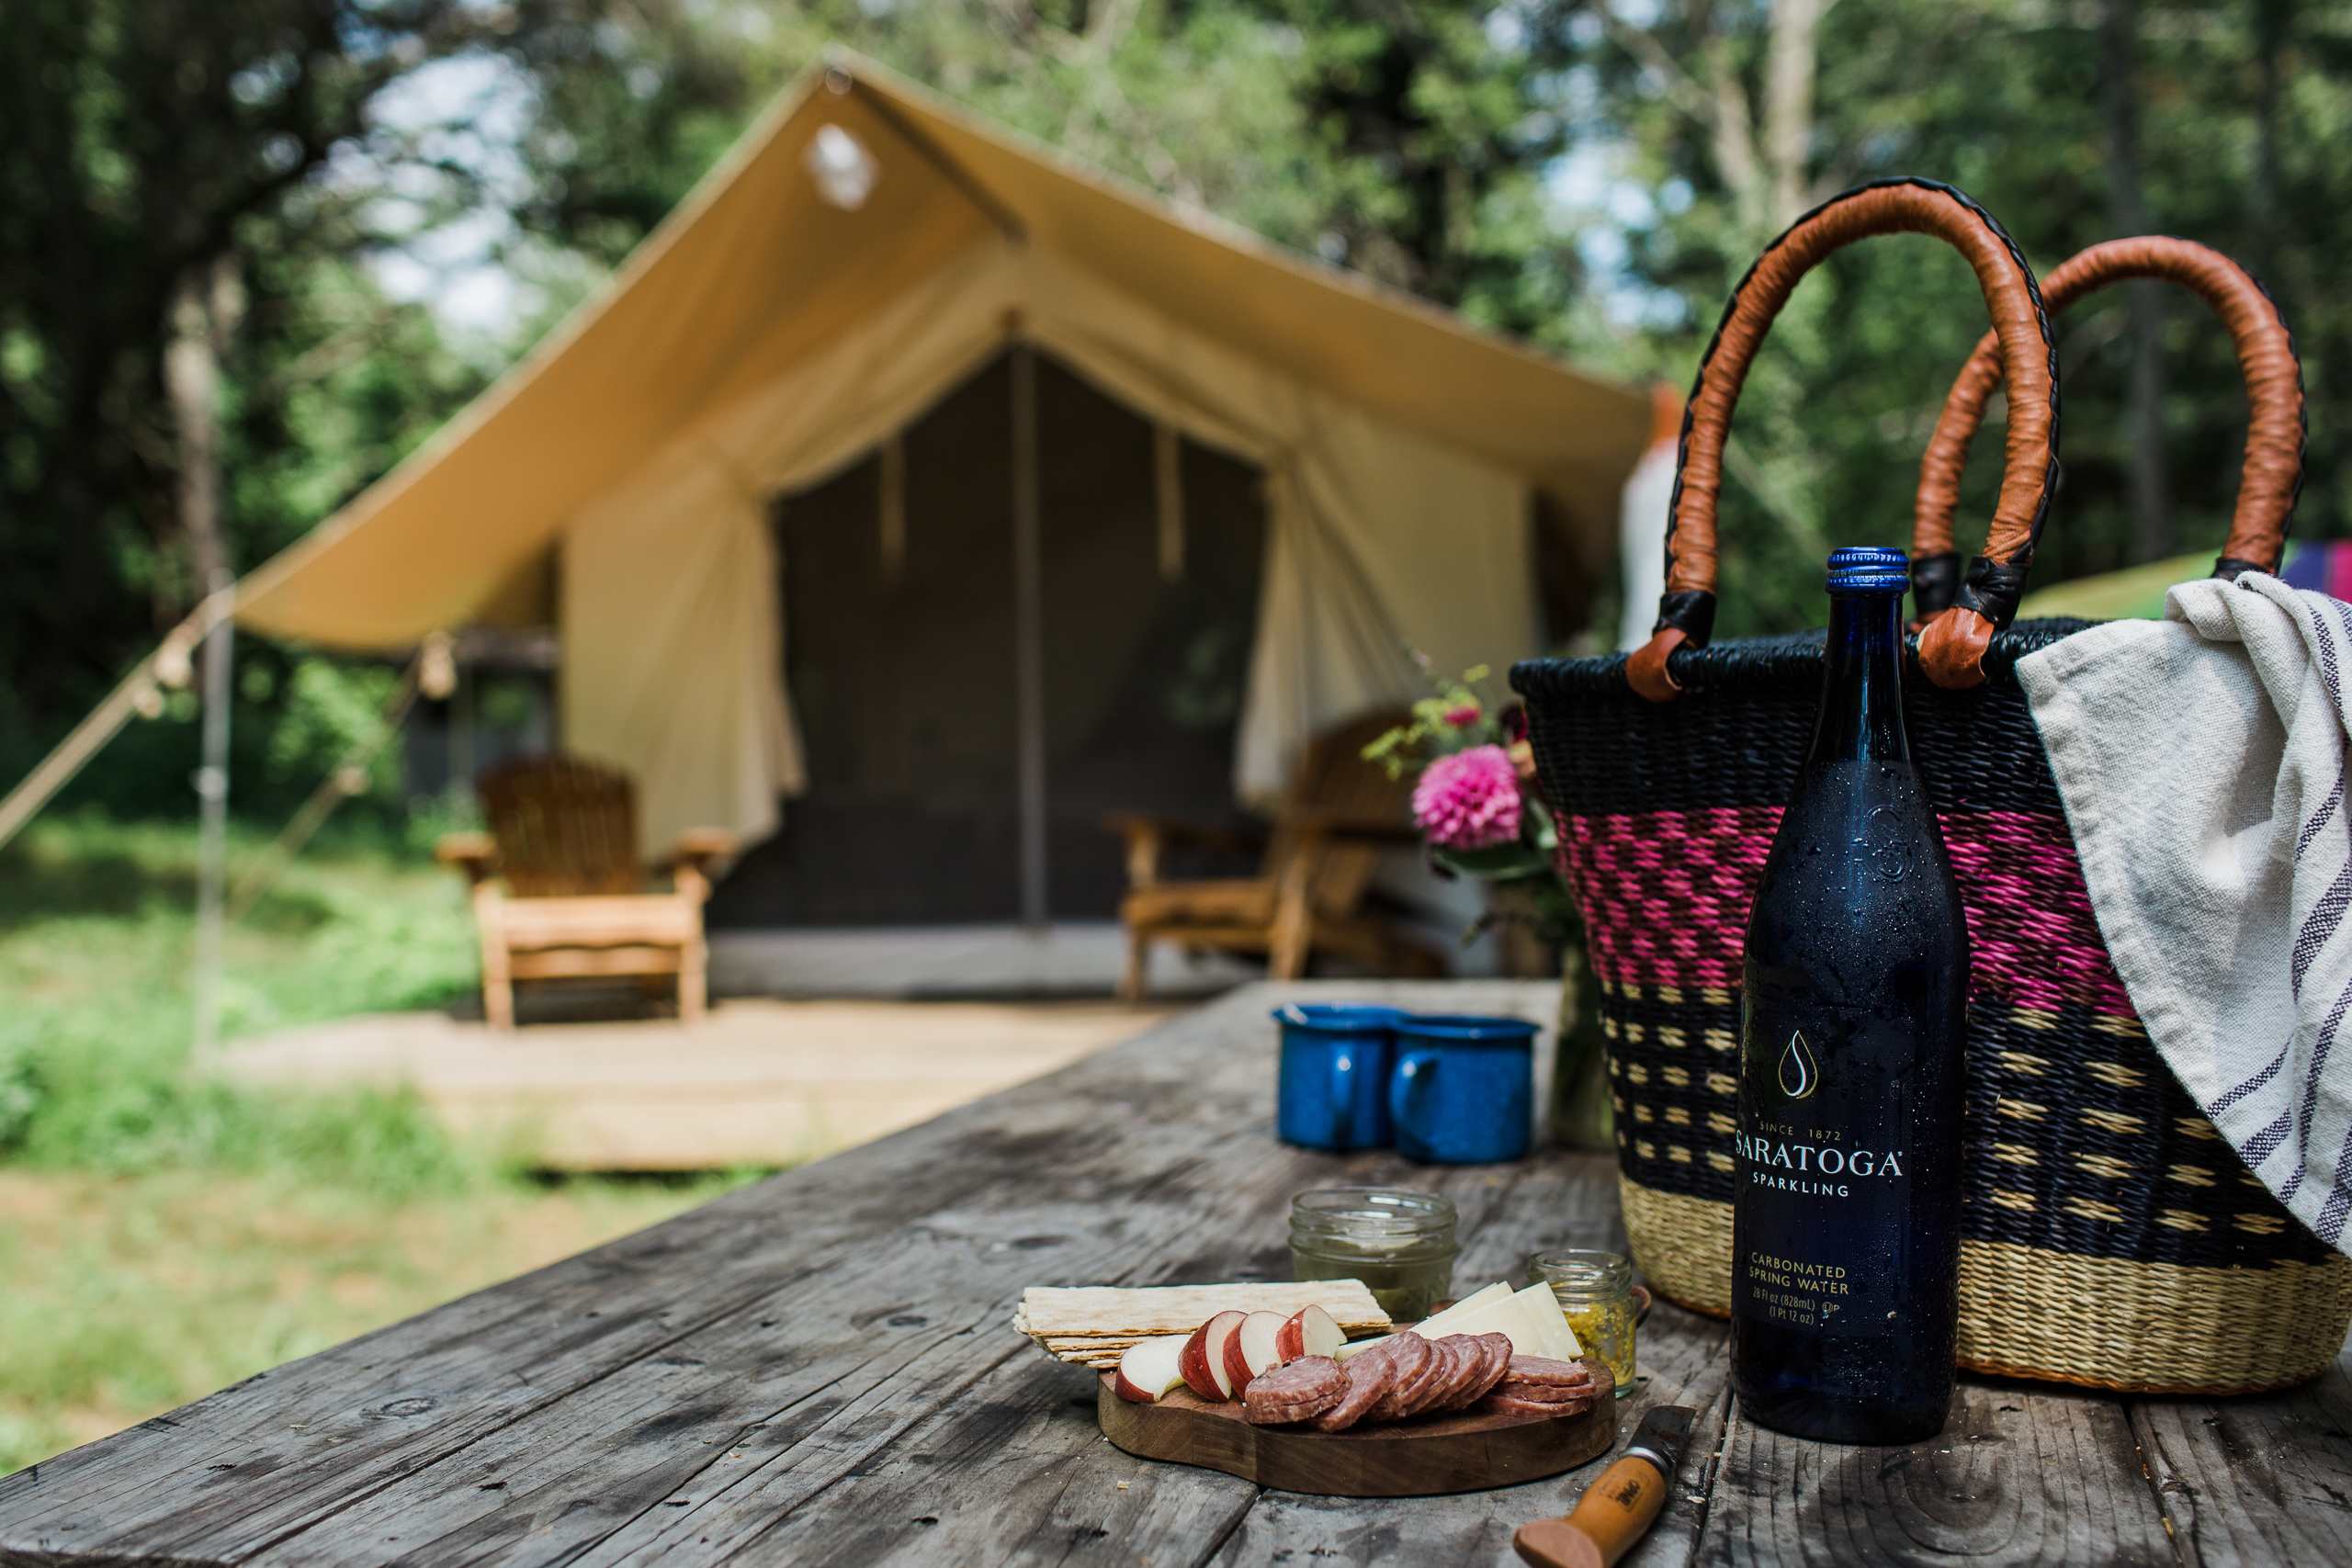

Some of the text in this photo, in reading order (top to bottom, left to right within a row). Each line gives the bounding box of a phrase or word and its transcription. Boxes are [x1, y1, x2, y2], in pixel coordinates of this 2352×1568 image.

[1759, 1121, 1841, 1141] SINCE 1872
[1753, 1171, 1849, 1197] SPARKLING
[1751, 1252, 1846, 1279] CARBONATED
[1748, 1266, 1849, 1295] SPRING WATER
[1770, 1293, 1779, 1303] oz
[1789, 1310, 1798, 1323] 12
[1800, 1313, 1815, 1325] oz)
